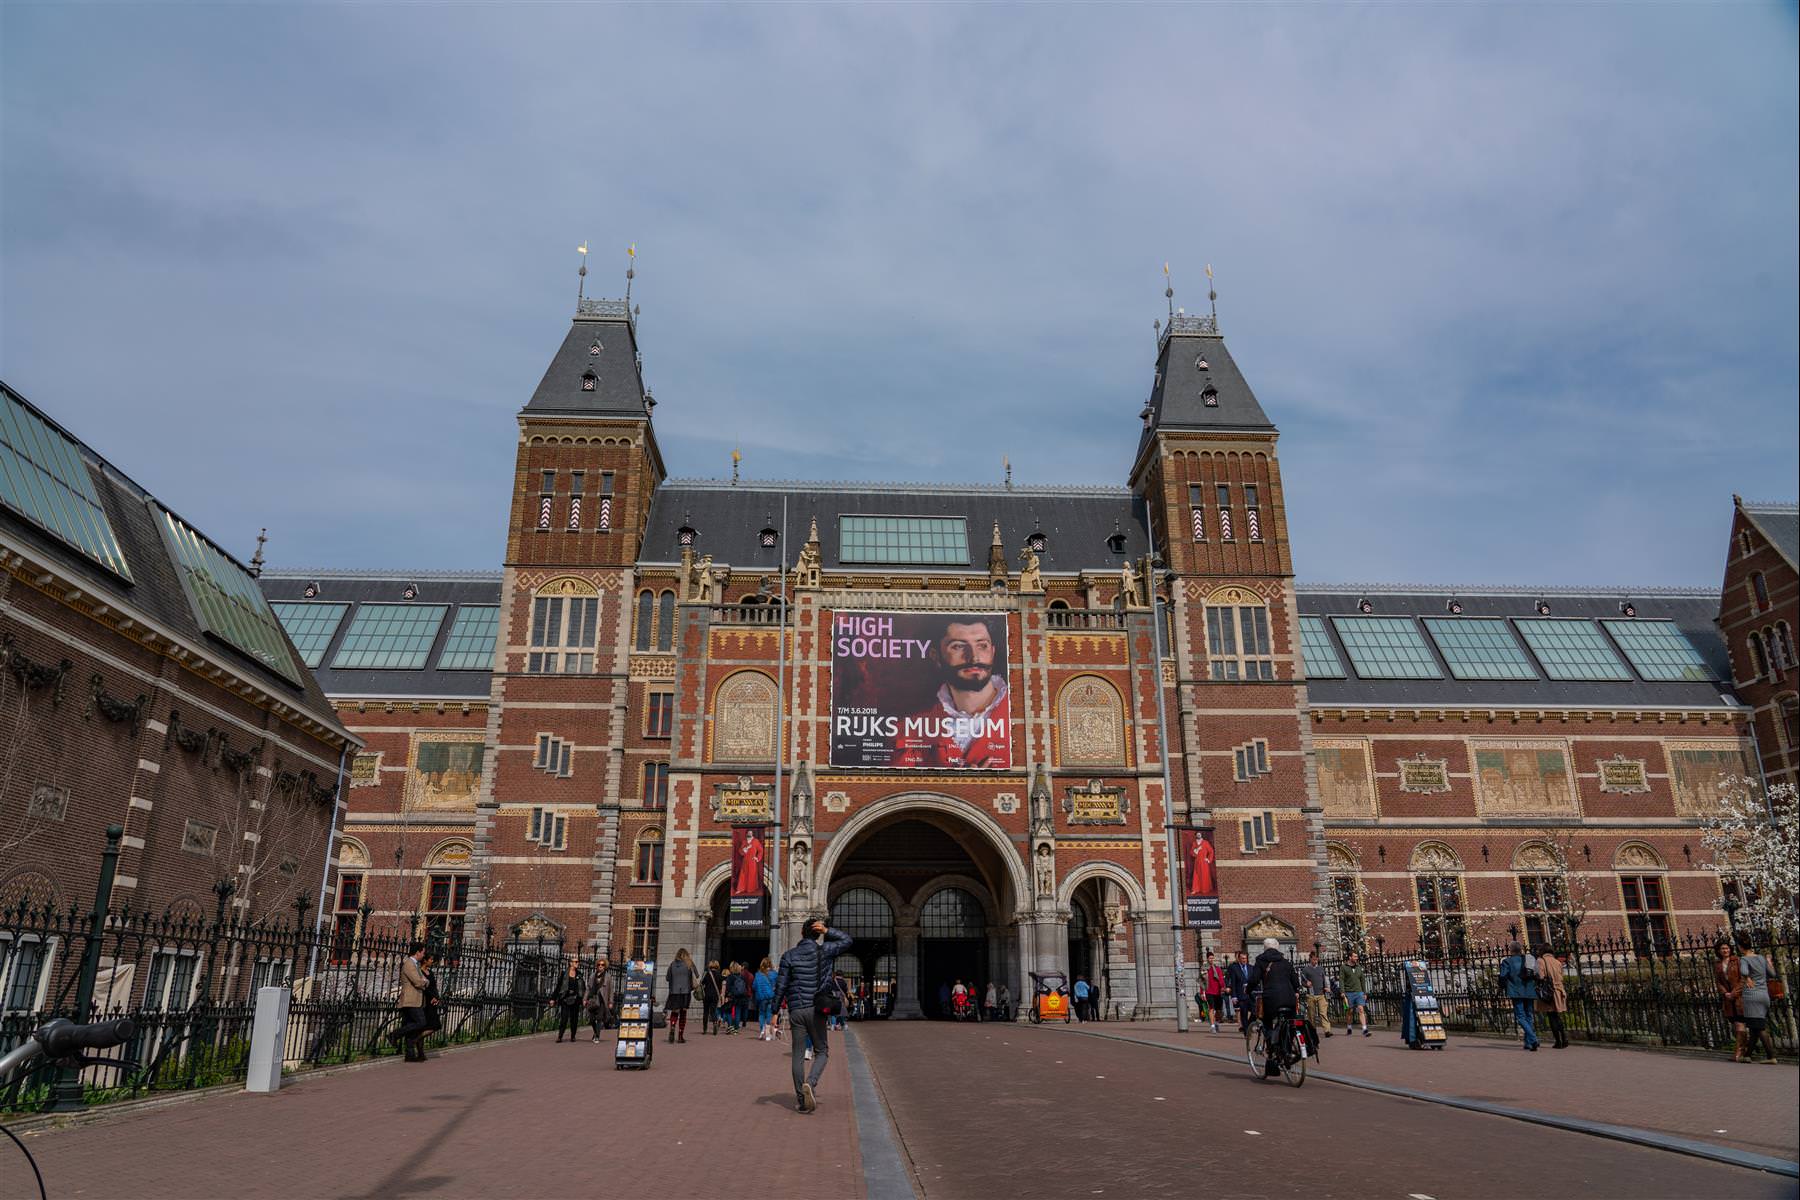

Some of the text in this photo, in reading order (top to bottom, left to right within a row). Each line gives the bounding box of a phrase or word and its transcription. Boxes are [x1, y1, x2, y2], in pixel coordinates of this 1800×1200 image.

[838, 616, 893, 636] HIGH
[837, 638, 931, 659] SOCIETY
[837, 715, 1005, 739] RIJKS MUSEUM
